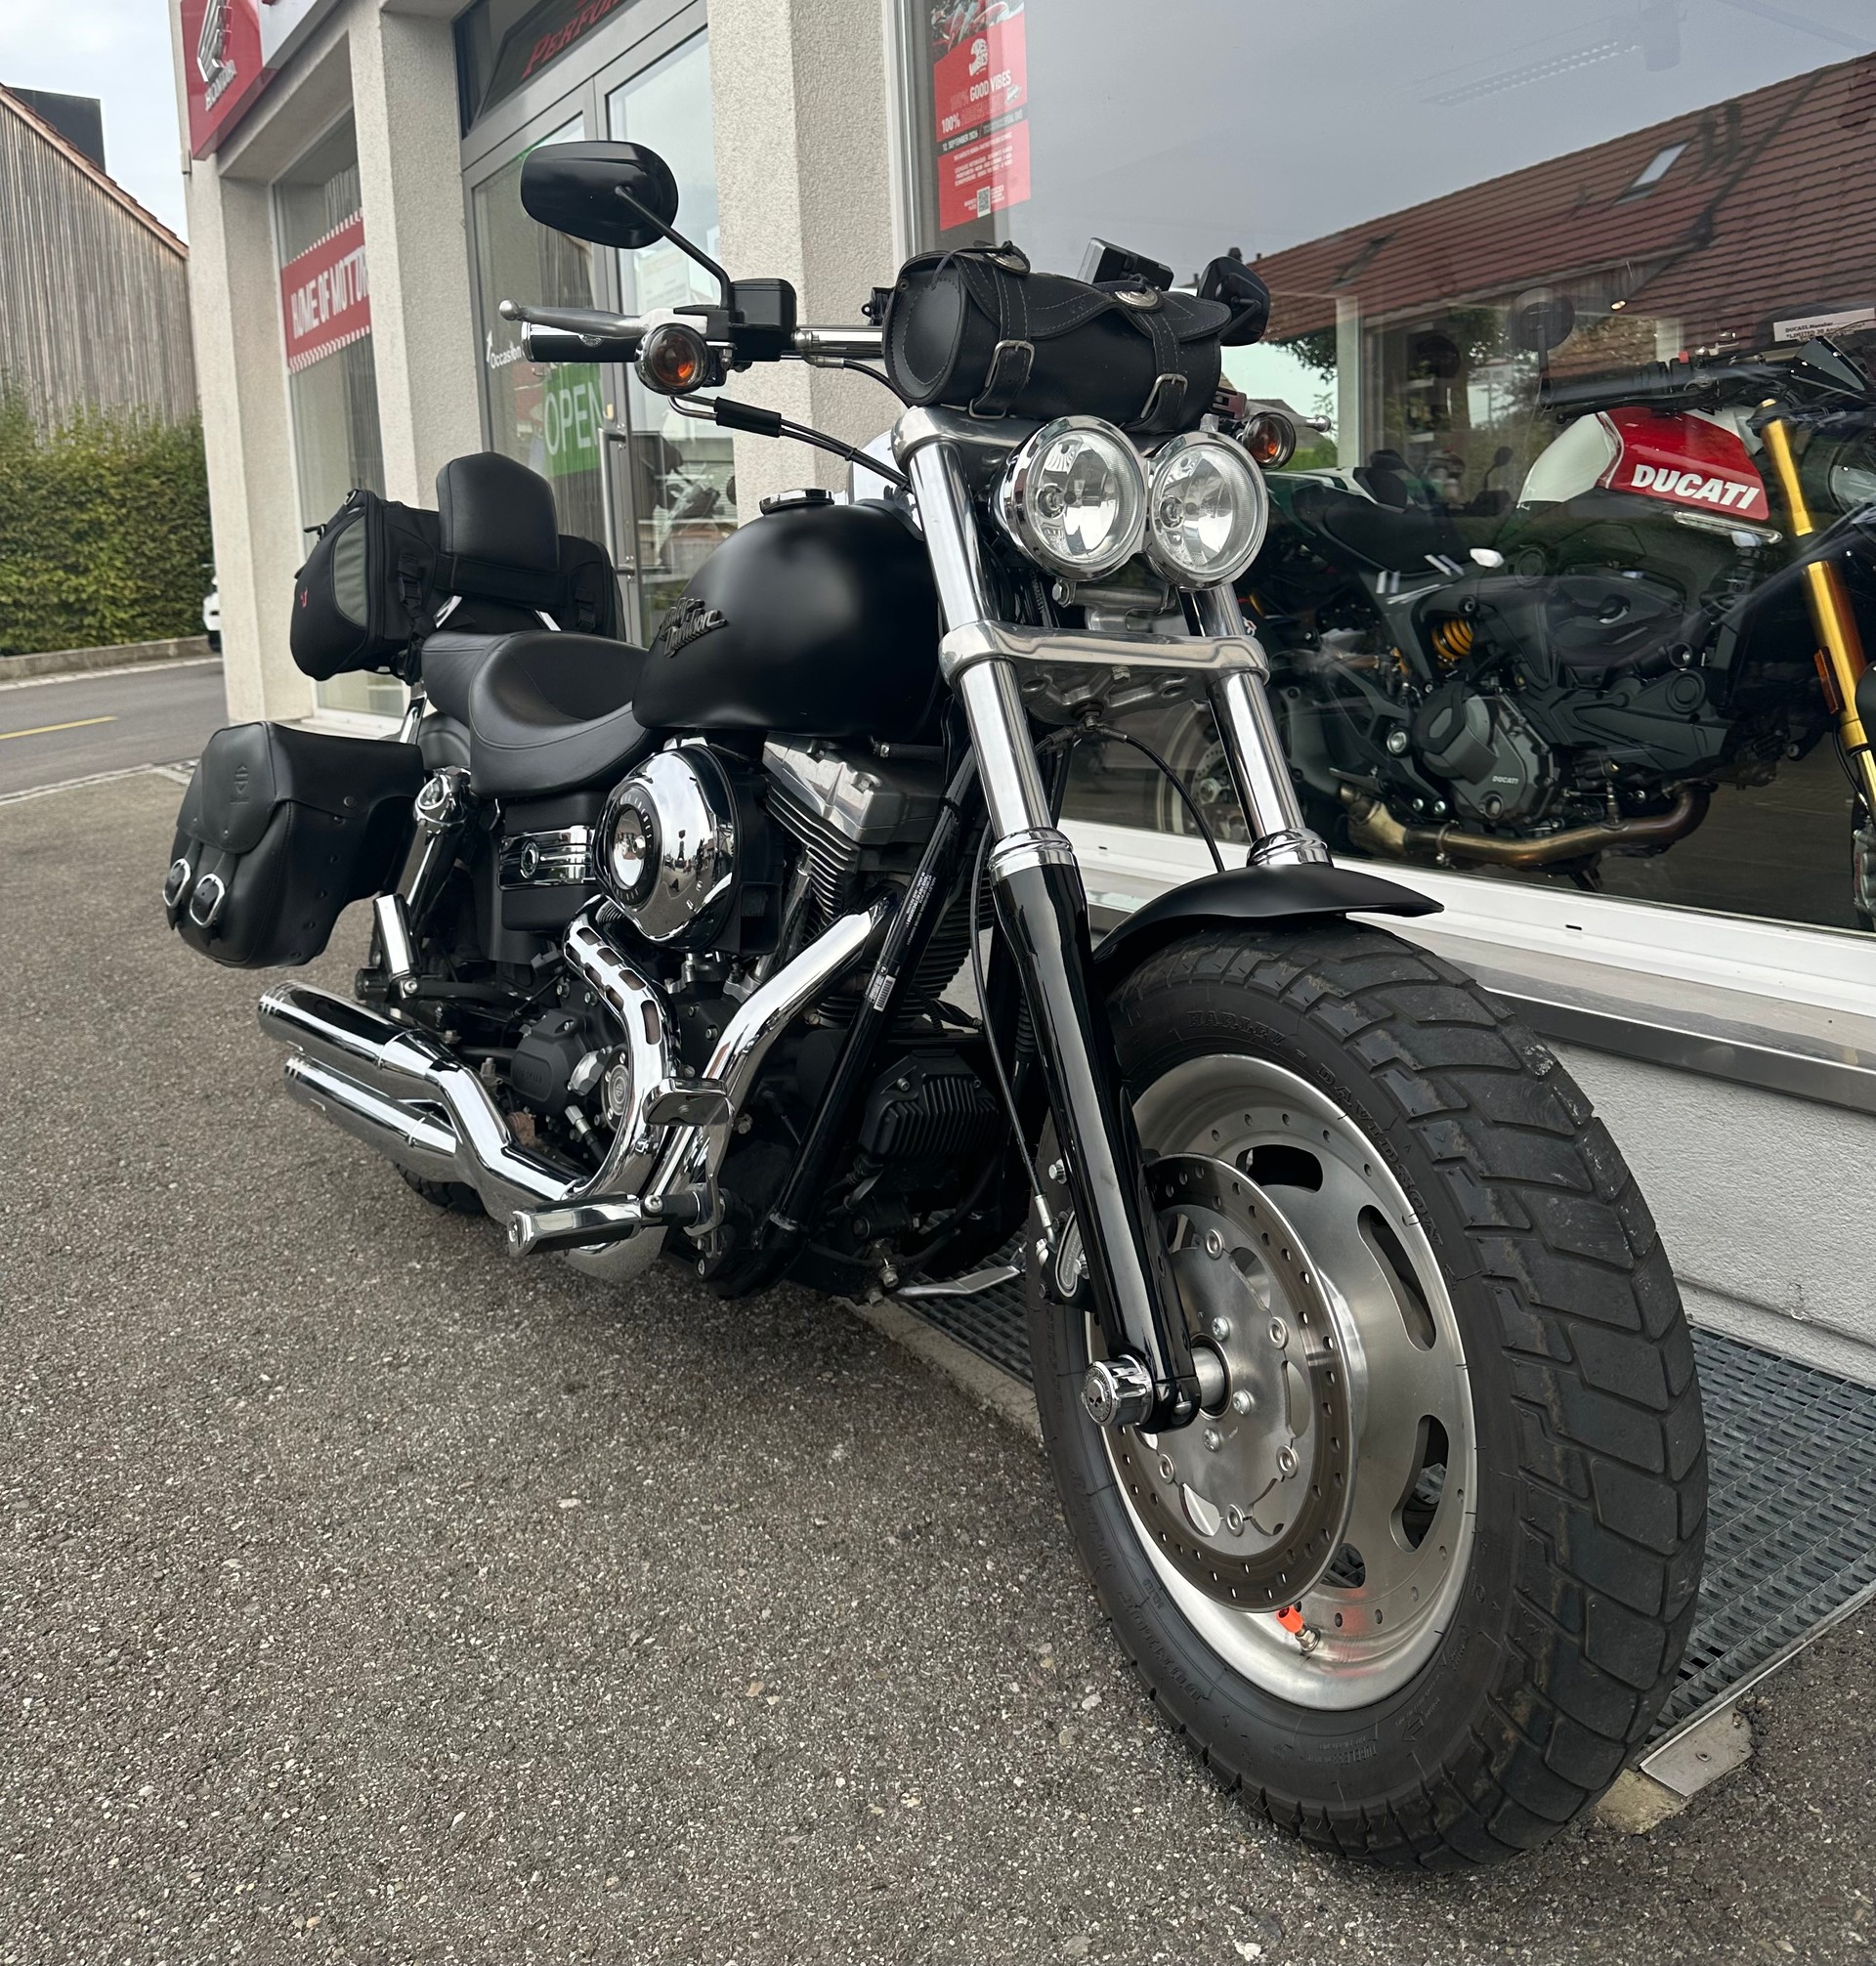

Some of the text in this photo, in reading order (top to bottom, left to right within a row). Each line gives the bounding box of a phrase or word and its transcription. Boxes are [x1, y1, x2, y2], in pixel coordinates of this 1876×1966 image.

[970, 80, 989, 102] GOOD
[990, 69, 1011, 92] VIBES
[942, 112, 960, 134] 100%
[291, 279, 320, 339] HOME
[318, 271, 330, 323] OF
[1785, 324, 1809, 333] DUCATI
[544, 382, 603, 455] OPEN
[1631, 464, 1760, 510] DUCATI
[1492, 775, 1519, 785] DUCATI
[1186, 1010, 1287, 1047] HARLEY
[1316, 1062, 1444, 1247] DAVIDSON
